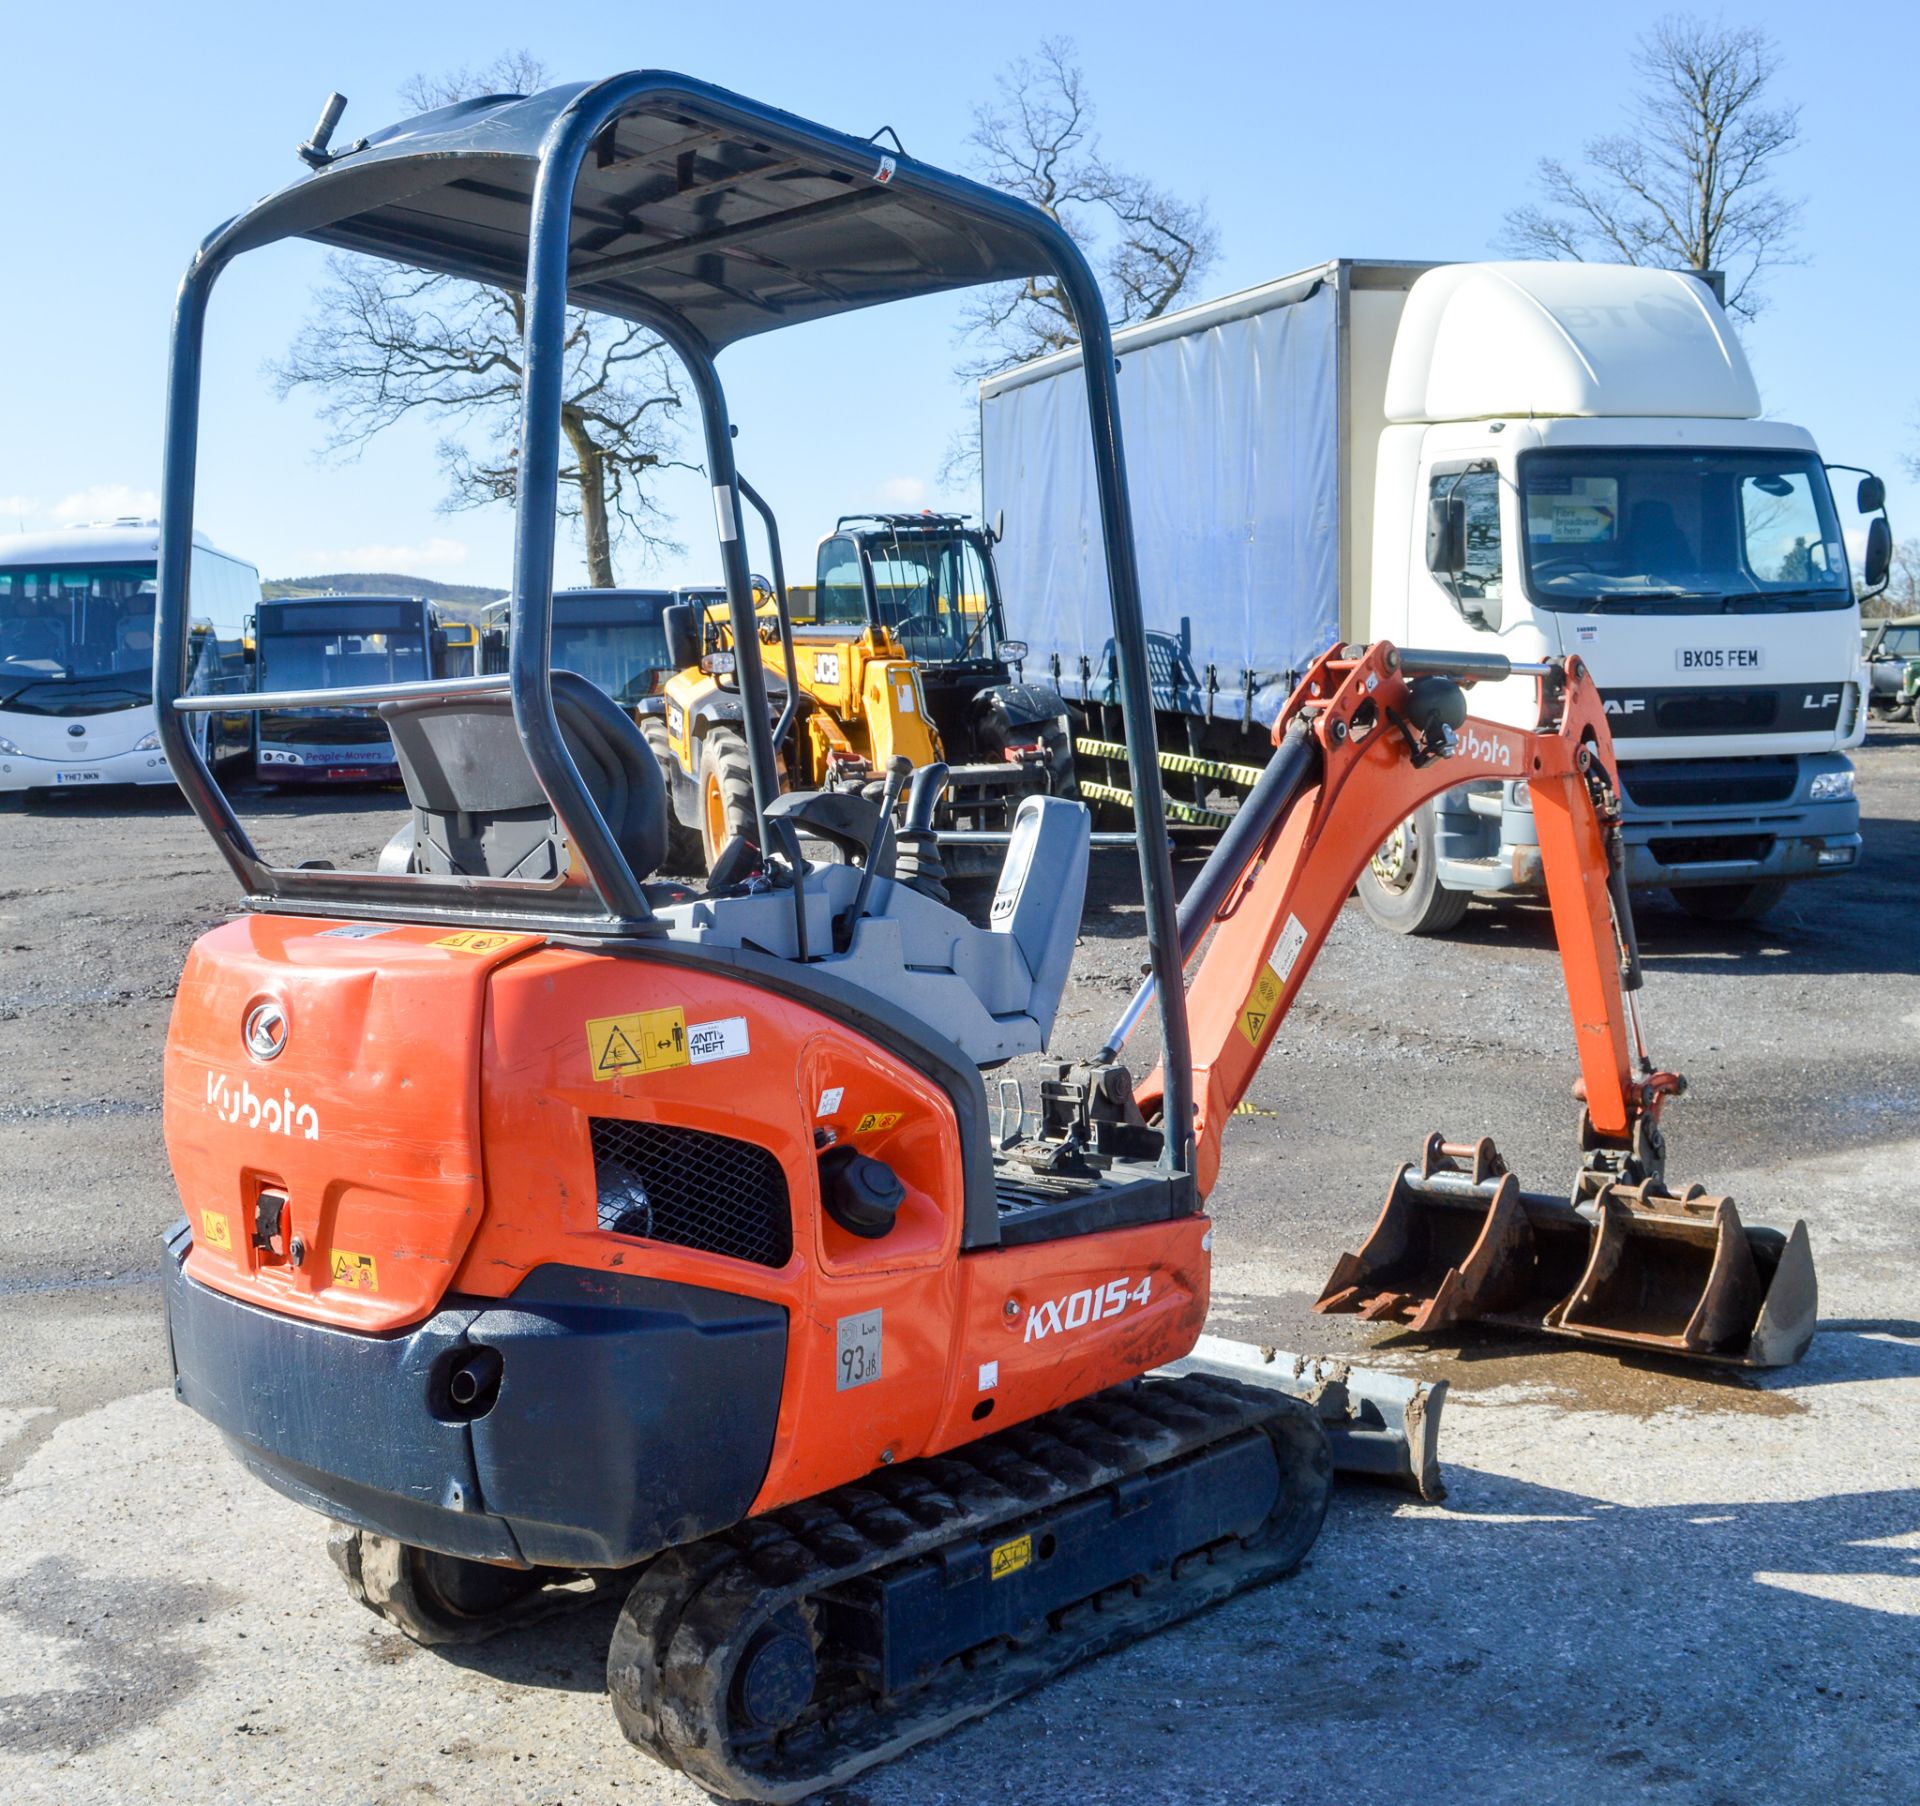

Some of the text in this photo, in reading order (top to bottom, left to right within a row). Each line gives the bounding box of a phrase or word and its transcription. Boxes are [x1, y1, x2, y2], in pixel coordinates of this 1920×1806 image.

[1555, 508, 1576, 517] Fibre
[1555, 517, 1599, 527] broadband
[1564, 527, 1582, 535] here
[1683, 649, 1758, 667] BX05 FEM
[814, 653, 838, 685] JCB
[1803, 693, 1839, 709] LF
[1453, 728, 1510, 766] ubota
[690, 1040, 725, 1056] THEFT
[205, 1069, 319, 1141] Kubota
[841, 1345, 865, 1383] 93
